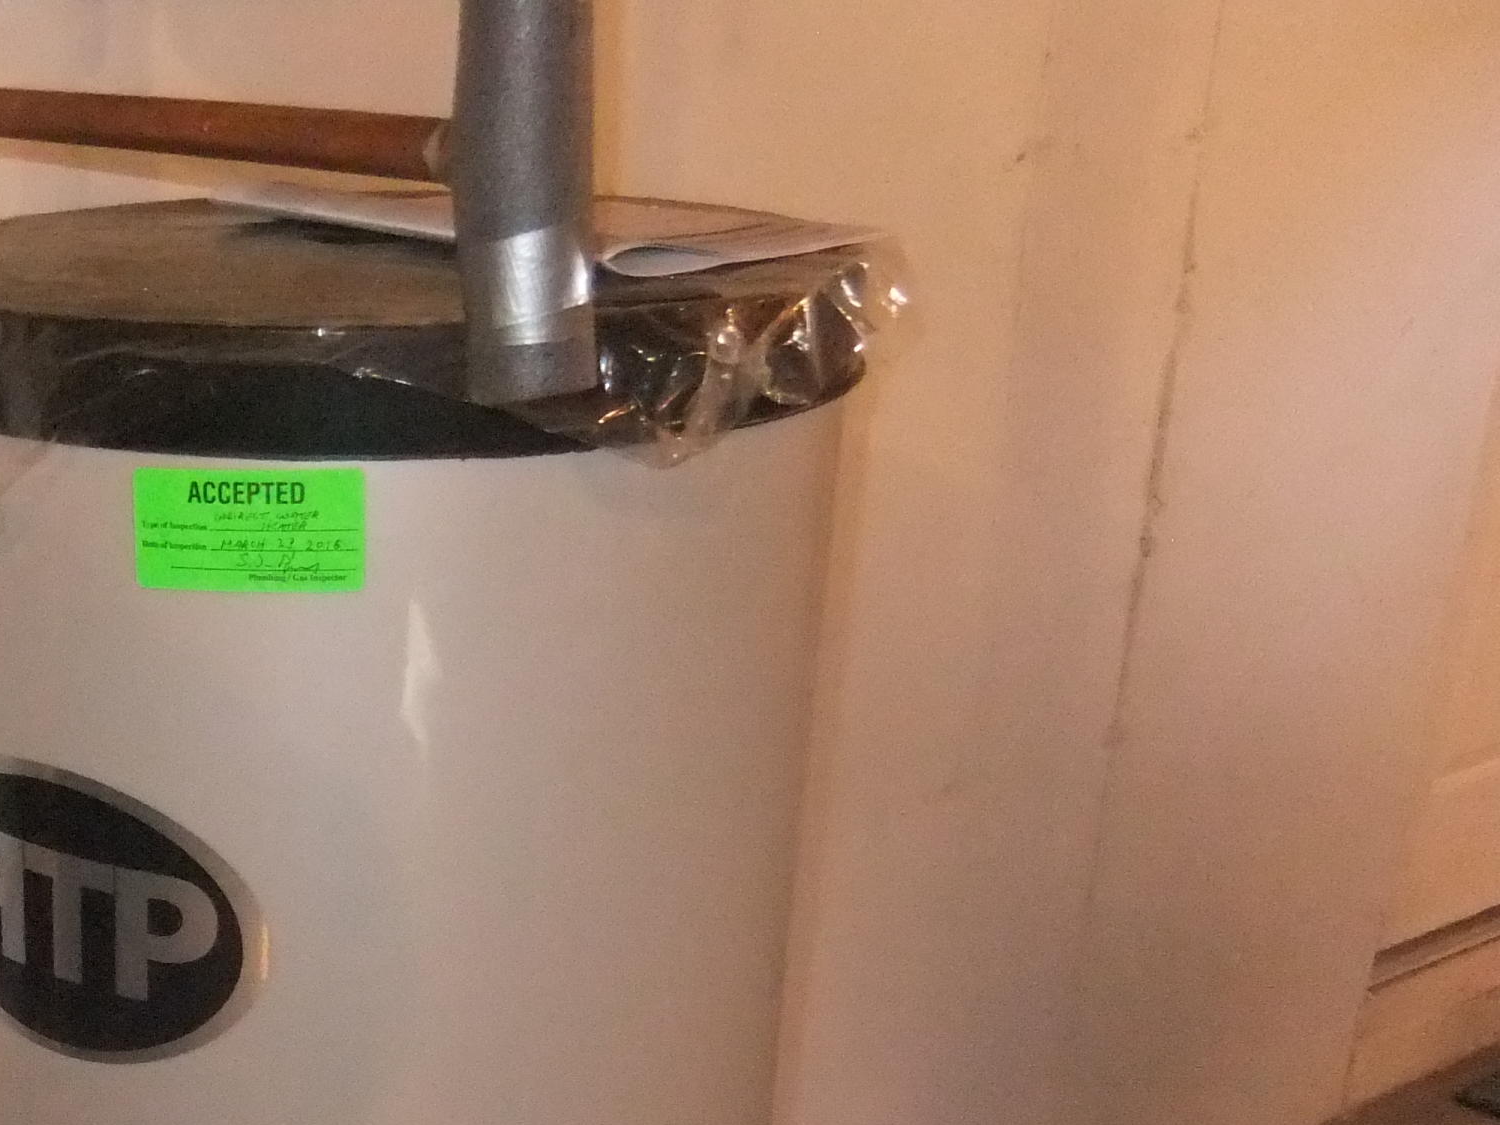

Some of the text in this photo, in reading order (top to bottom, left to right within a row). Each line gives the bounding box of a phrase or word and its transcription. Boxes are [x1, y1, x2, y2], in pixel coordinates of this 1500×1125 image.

[187, 480, 305, 504] ACCEPTED
[220, 538, 265, 551] MARCH
[306, 539, 341, 551] 2016
